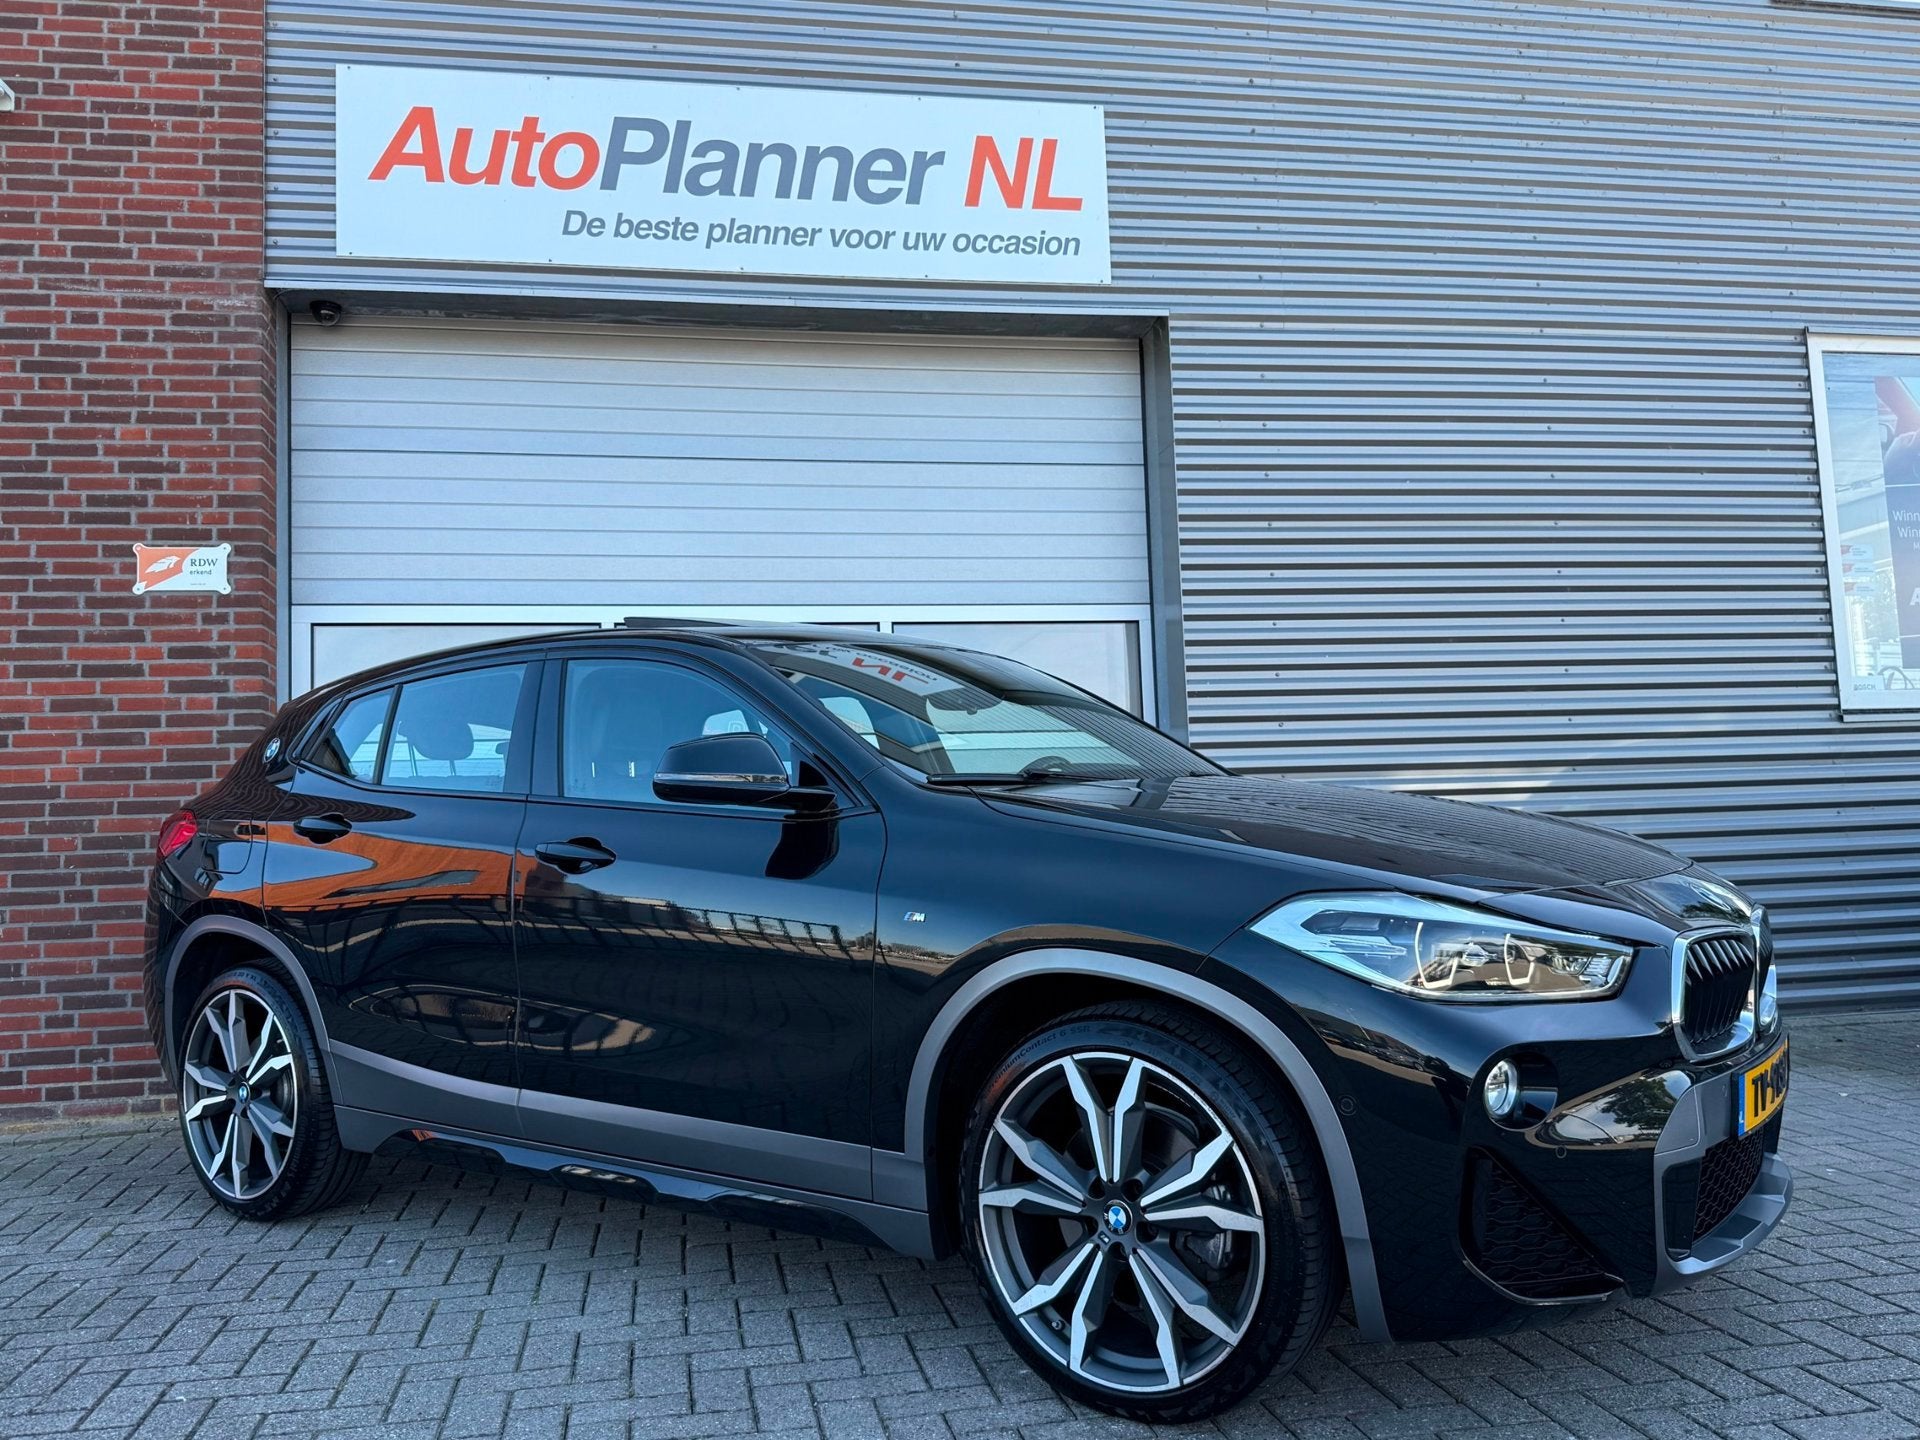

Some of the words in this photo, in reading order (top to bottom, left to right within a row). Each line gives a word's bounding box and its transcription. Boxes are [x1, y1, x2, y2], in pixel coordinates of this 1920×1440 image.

[368, 106, 946, 206] AutoPlanner
[965, 135, 1083, 211] NL
[562, 210, 606, 238] De
[613, 213, 700, 242] beste
[705, 218, 823, 250] planner
[829, 228, 897, 250] voor
[902, 231, 947, 252] uw
[952, 234, 1081, 256] occasion
[190, 558, 218, 567] RDW
